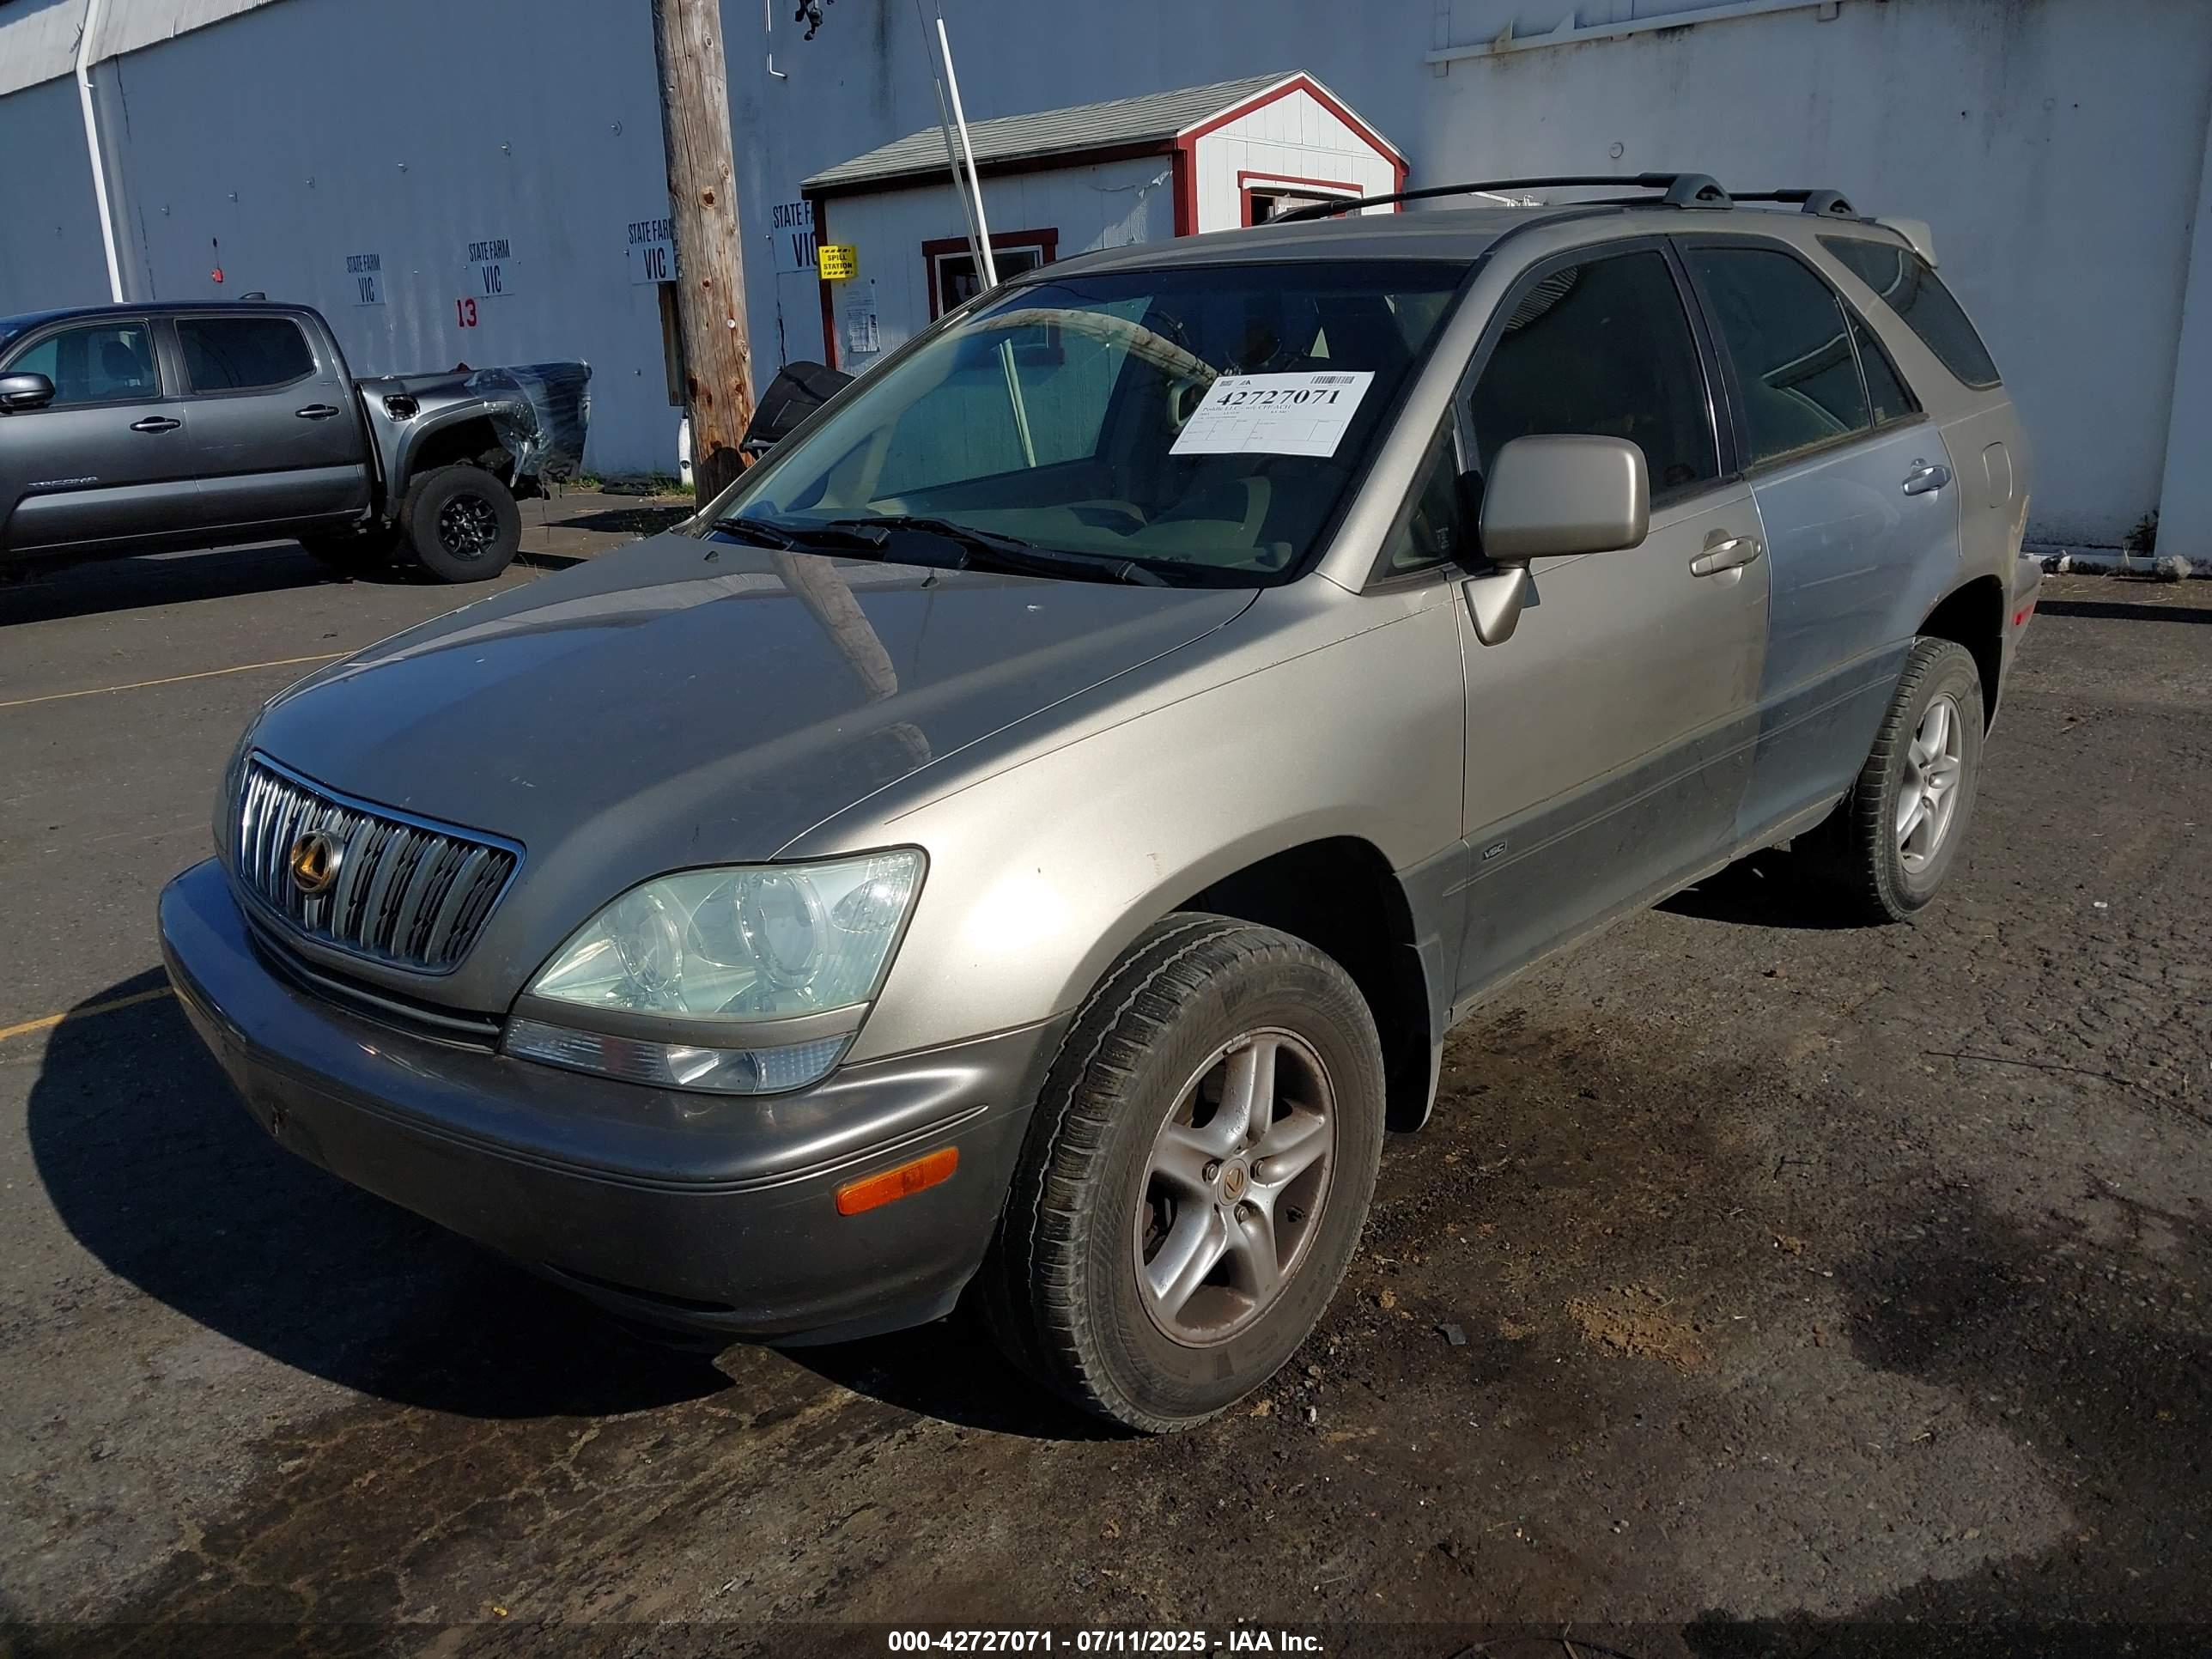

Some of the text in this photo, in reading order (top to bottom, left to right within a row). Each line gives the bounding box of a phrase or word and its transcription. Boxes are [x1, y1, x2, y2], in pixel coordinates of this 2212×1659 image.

[773, 202, 802, 229] STATE
[628, 222, 651, 245] STATE
[468, 239, 510, 262] STATE FARM
[346, 253, 380, 273] STATE FARM
[643, 247, 666, 280] VIC
[357, 276, 375, 302] VIC
[482, 264, 502, 294] VIC
[455, 298, 477, 327] 13
[1216, 389, 1340, 405] 42727071
[27, 476, 99, 487] TACOMA
[1484, 842, 1505, 859] VSC
